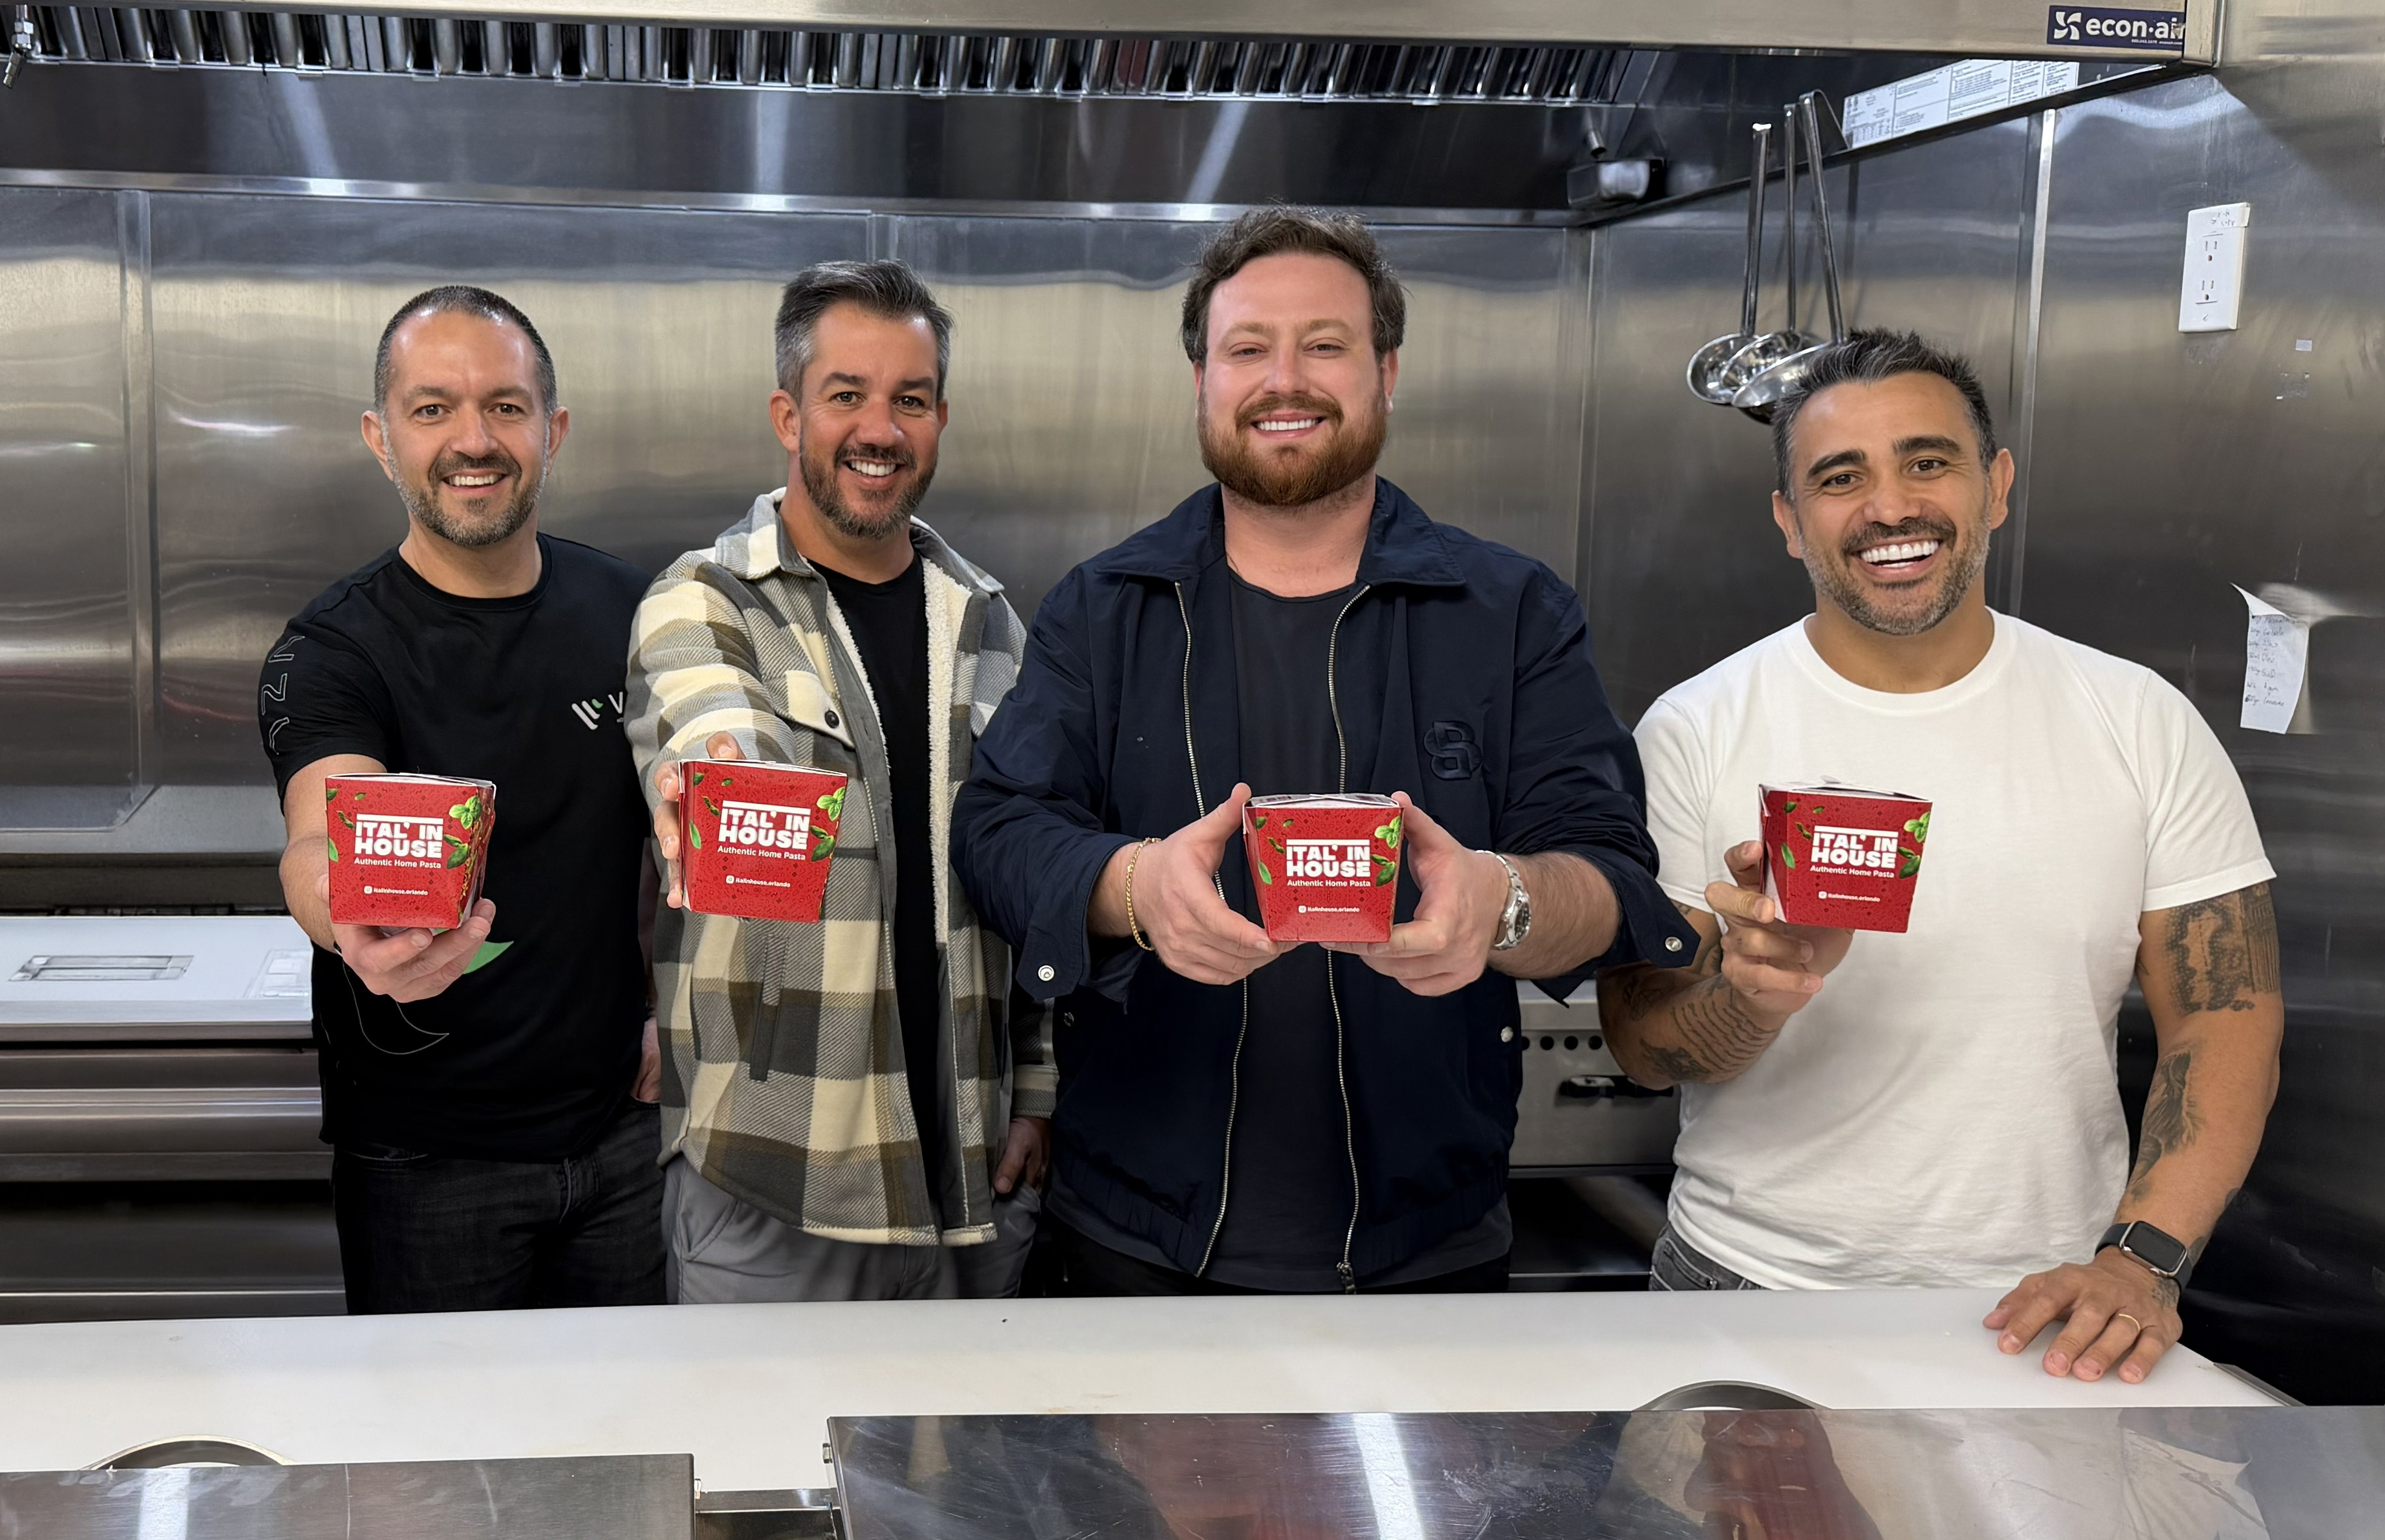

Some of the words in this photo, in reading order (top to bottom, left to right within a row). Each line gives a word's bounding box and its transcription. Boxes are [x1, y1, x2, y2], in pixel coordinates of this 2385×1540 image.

[721, 808, 777, 828] ITAL'
[786, 815, 810, 831] IN
[355, 821, 410, 838] ITAL'
[419, 824, 443, 841] IN
[718, 824, 808, 850] HOUSE
[354, 837, 443, 858] HOUSE
[1813, 832, 1866, 850] ITAL'
[1874, 837, 1898, 852] IN
[717, 845, 756, 856] Authentic
[758, 849, 782, 859] Home
[784, 851, 806, 861] Pasta
[1286, 844, 1338, 860] ITAL'
[1347, 846, 1370, 860] IN
[1811, 847, 1896, 869] HOUSE
[354, 857, 392, 866] Authentic
[394, 859, 417, 868] Home
[420, 860, 441, 869] Pasta
[1286, 860, 1371, 878] HOUSE
[1810, 865, 1847, 875] Authentic
[1849, 867, 1871, 877] Home
[1873, 870, 1894, 878] Pasta
[1350, 879, 1371, 887] Pasta
